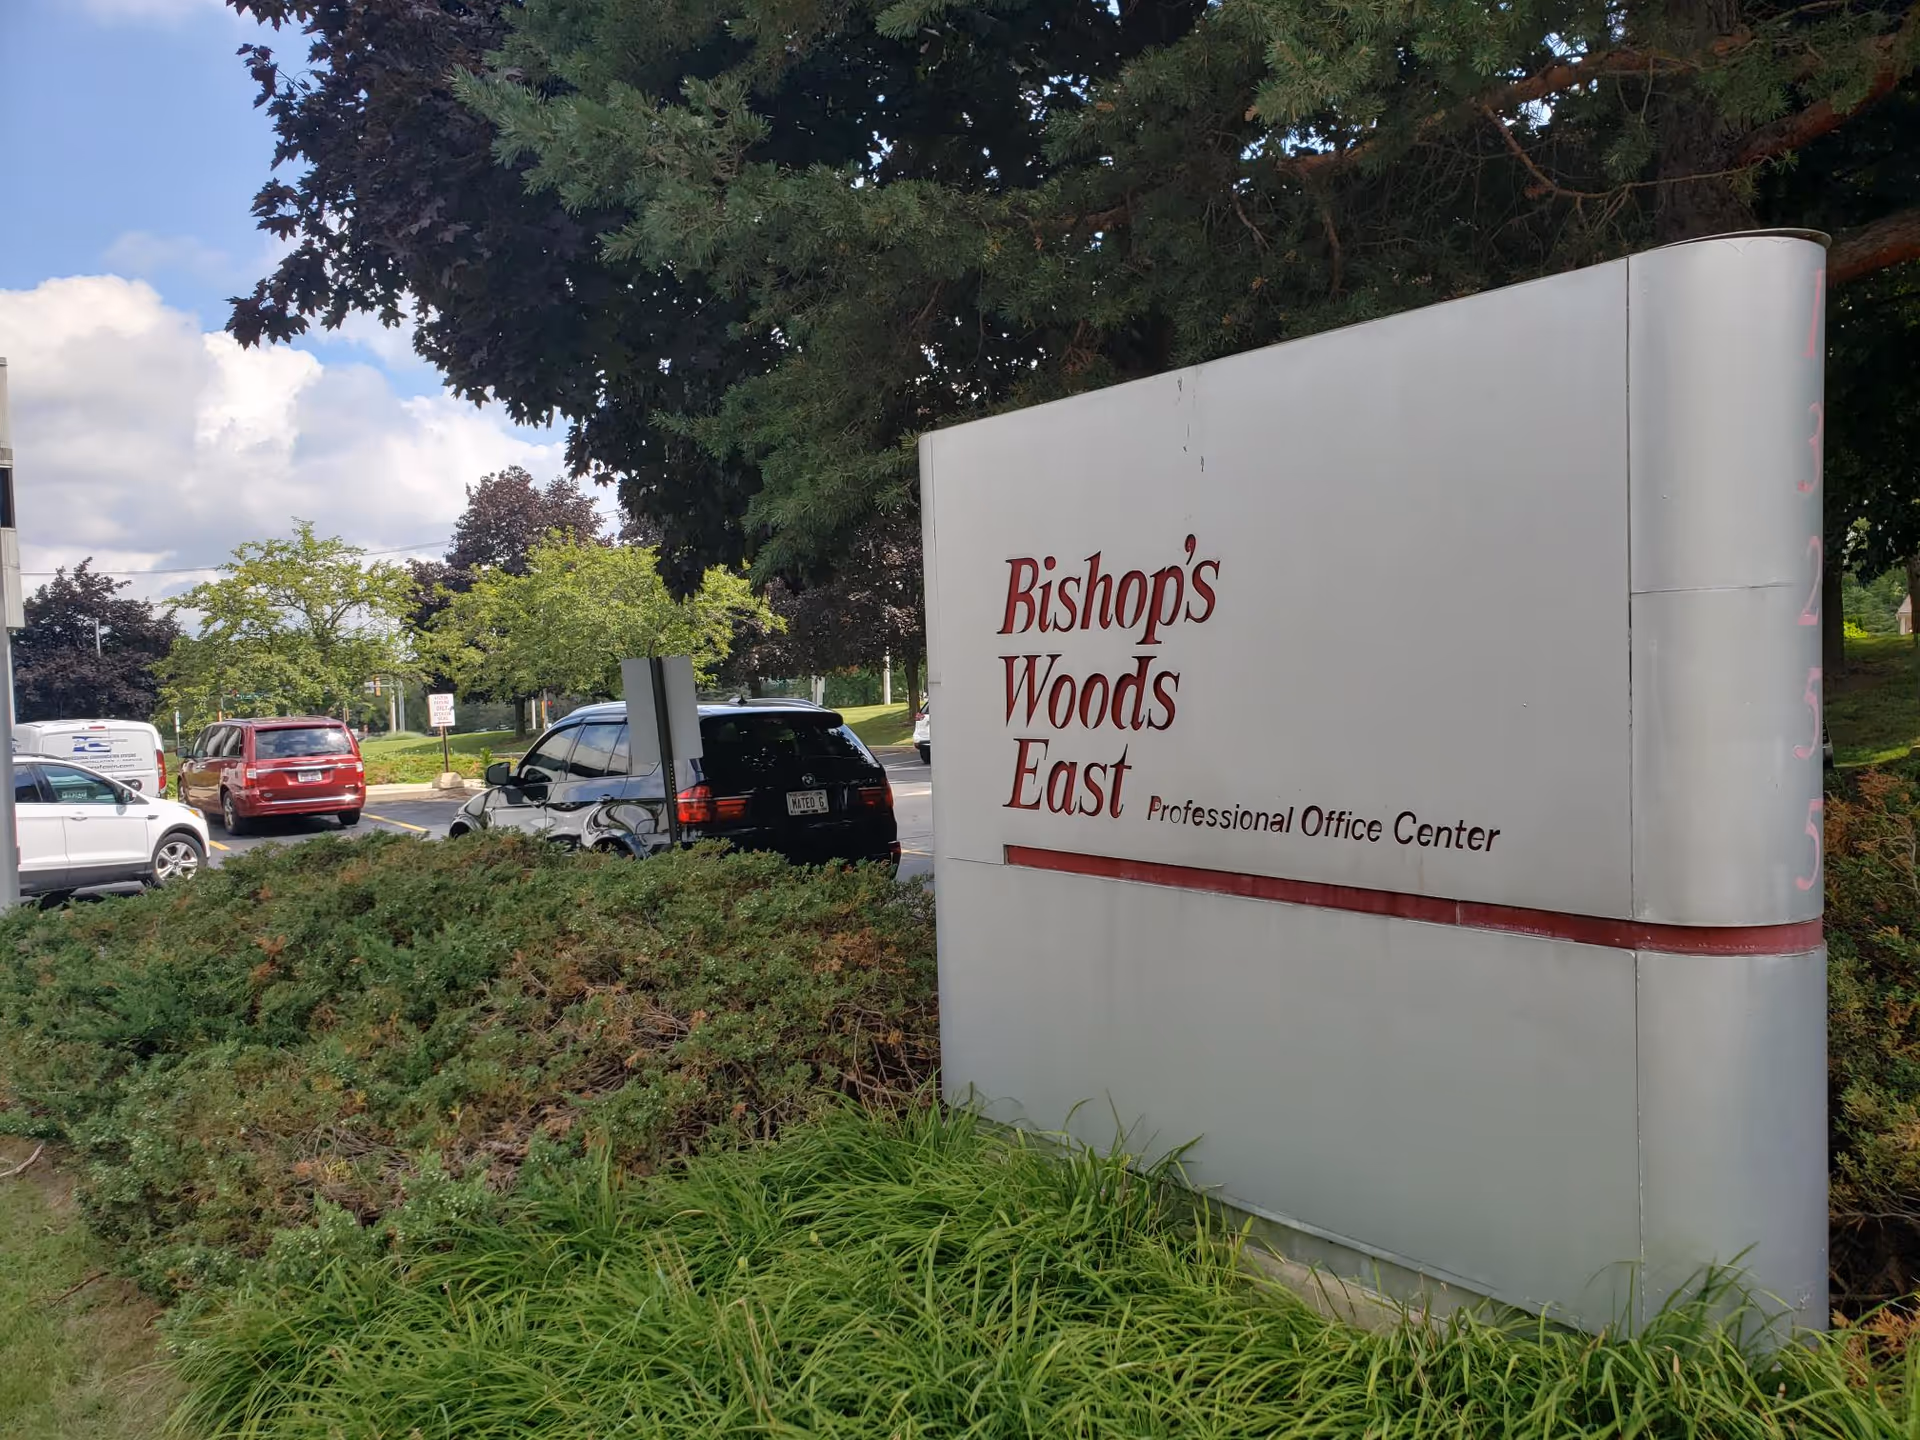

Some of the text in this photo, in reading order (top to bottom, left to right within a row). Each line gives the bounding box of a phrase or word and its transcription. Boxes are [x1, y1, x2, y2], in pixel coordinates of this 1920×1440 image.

[996, 533, 1221, 645] Bishop's
[998, 653, 1181, 731] Woods
[791, 796, 815, 809] MATEO
[1002, 737, 1502, 853] East Professional Office Center
